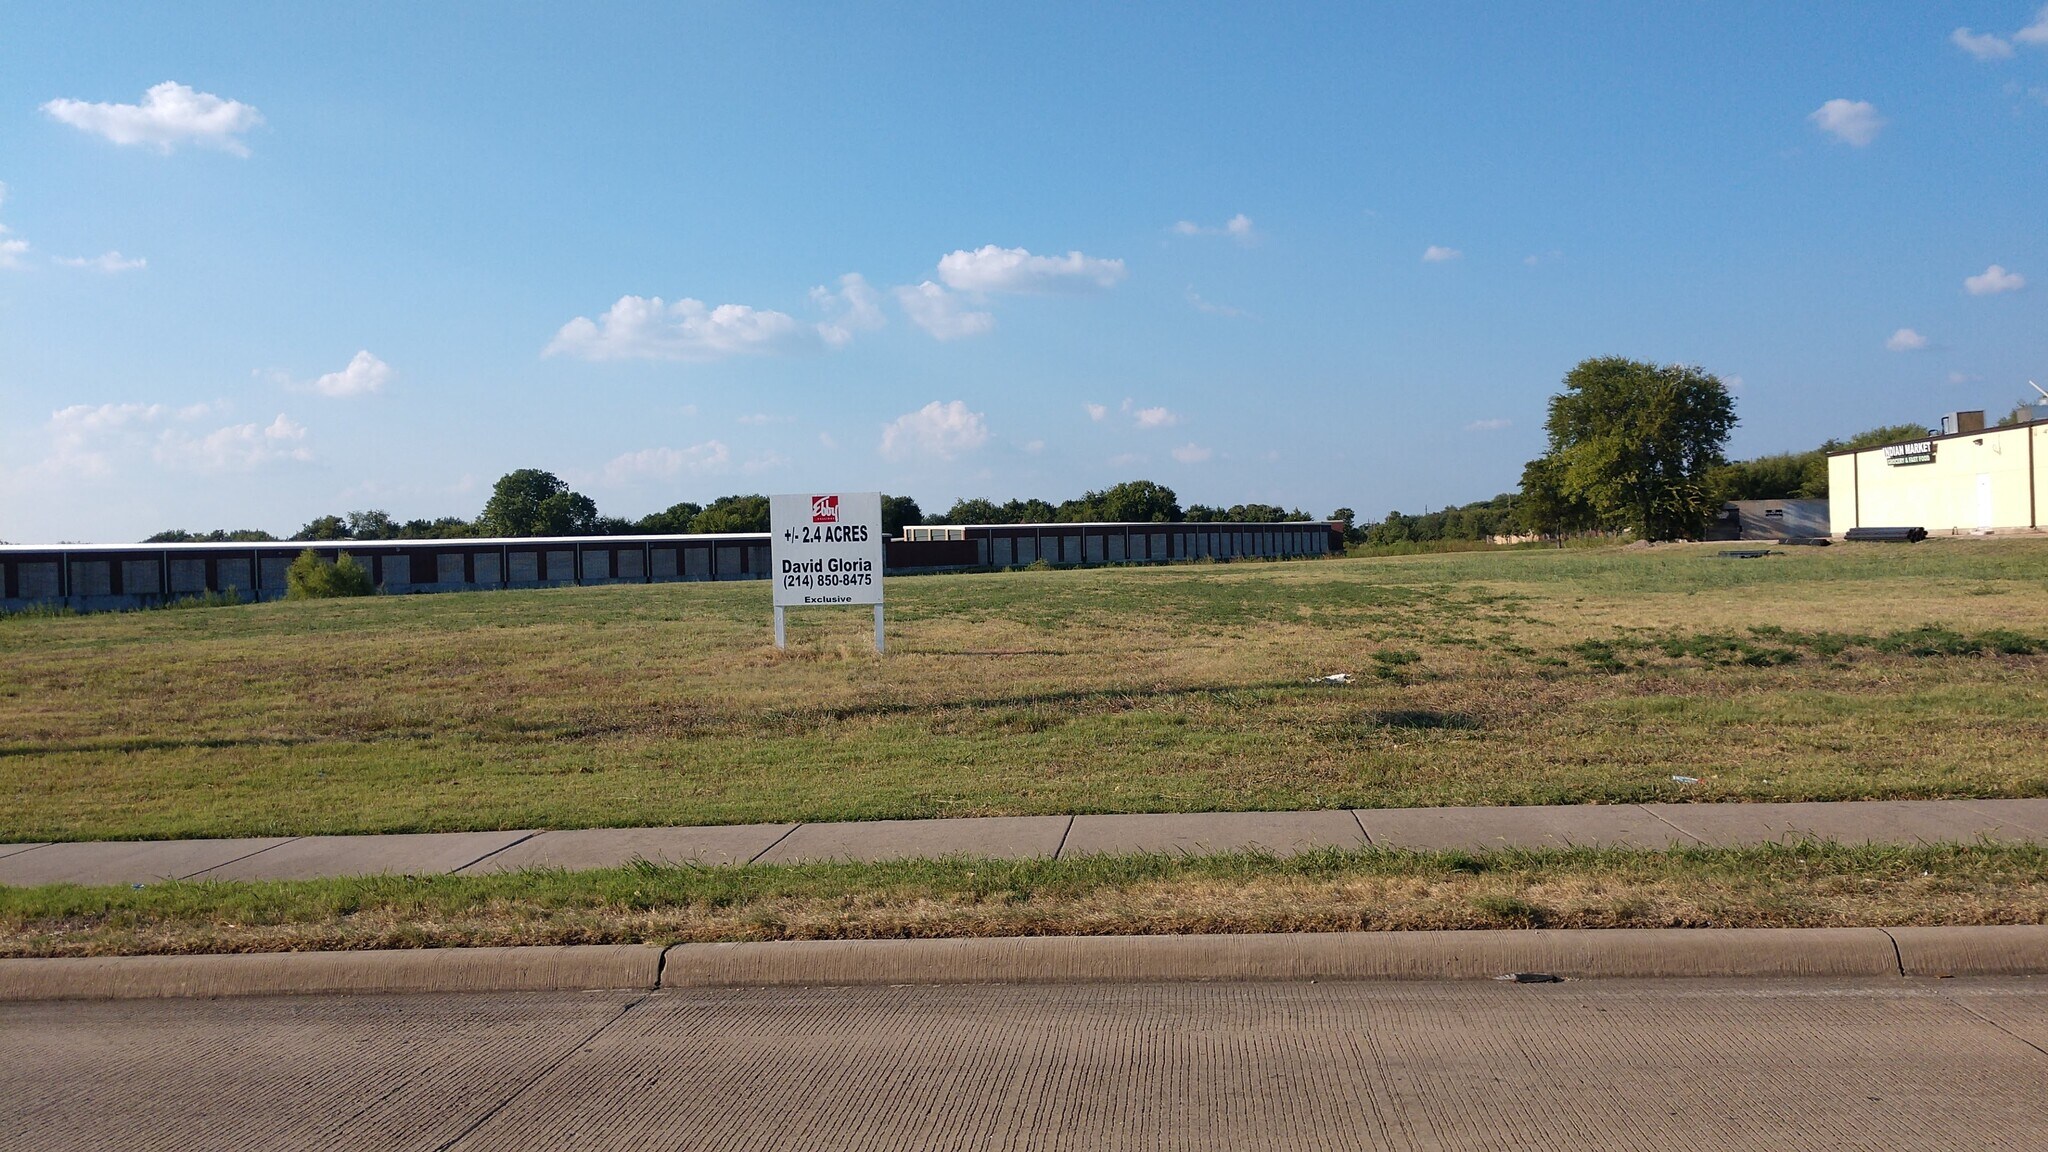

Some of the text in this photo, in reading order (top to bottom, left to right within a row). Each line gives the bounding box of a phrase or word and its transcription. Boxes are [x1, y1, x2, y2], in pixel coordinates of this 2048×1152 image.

[1883, 442, 1932, 457] INDIAN MARKET
[1919, 455, 1931, 463] FOOD
[812, 496, 839, 522] Ebby
[784, 525, 868, 543] +/- 2.4 ACRES
[782, 558, 872, 574] David Gloria
[783, 574, 872, 590] (214) 850-8475
[804, 596, 852, 604] Exclusive
